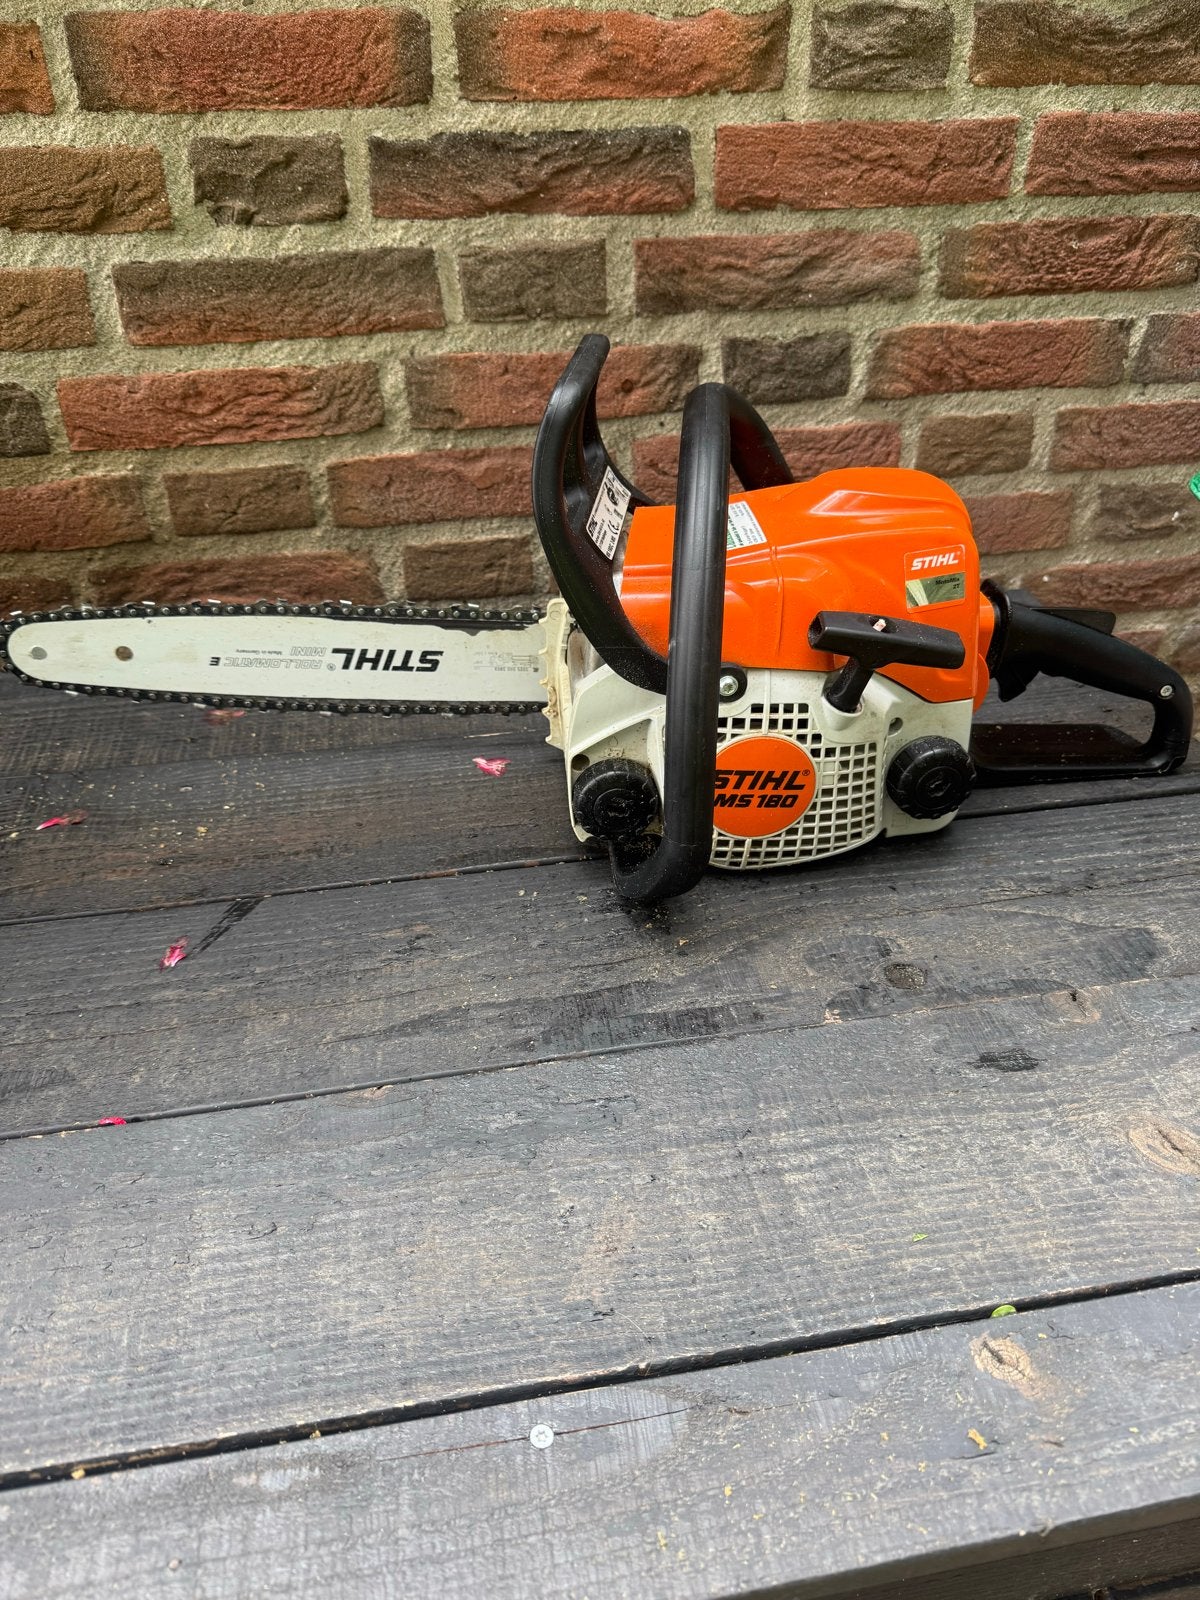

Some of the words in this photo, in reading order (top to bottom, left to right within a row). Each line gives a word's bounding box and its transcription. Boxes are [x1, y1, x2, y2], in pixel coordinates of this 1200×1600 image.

[911, 552, 959, 571] STIHL
[290, 646, 328, 657] MINI
[209, 656, 221, 667] E
[223, 656, 323, 670] ROLLOMATIC
[714, 794, 754, 809] MS
[756, 794, 799, 809] 180
